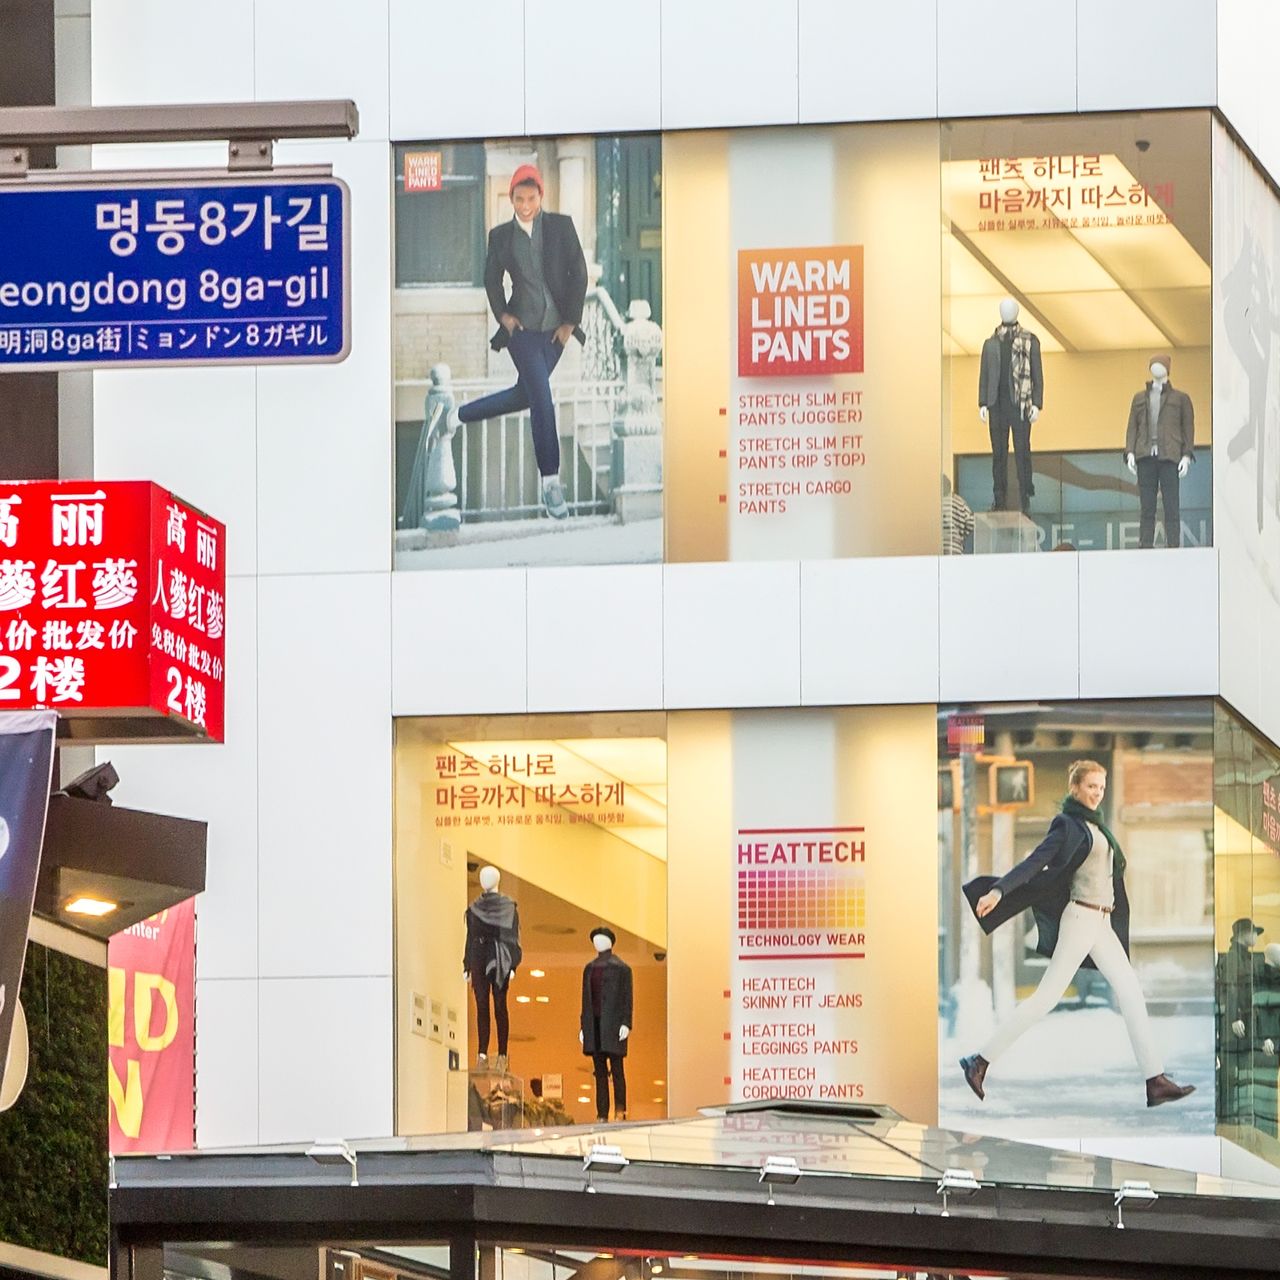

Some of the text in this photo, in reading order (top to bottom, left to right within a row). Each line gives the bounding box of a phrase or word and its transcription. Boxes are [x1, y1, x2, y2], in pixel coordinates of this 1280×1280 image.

[409, 156, 437, 168] WARM
[979, 154, 1103, 182] 팬츠 하나로
[409, 167, 437, 177] LINED
[409, 177, 437, 188] PANTS
[979, 182, 1175, 214] 마음까지 따스하게
[96, 195, 328, 256] 명동8가길
[751, 259, 850, 293] WARM
[0, 266, 328, 311] eongdong 8ga-gil
[751, 294, 850, 329] LINED
[751, 329, 850, 363] PANTS
[739, 391, 863, 408] STRETCH SLIM FIT
[739, 409, 863, 426] PANTS (JOGGER)
[739, 434, 863, 452] STRETCH SLIM FIT
[739, 452, 866, 470] PANTS (RIP STOP)
[739, 480, 852, 496] STRETCH CARGO
[739, 499, 786, 514] PANTS
[166, 504, 217, 572] 高丽
[0, 619, 138, 652] 价批发价
[0, 655, 85, 702] 2楼
[166, 666, 208, 728] 2楼
[436, 753, 557, 779] 팬츠 하나로
[436, 781, 625, 810] 마음까지 따스하게
[738, 841, 866, 865] HEATTECH
[738, 933, 866, 948] TECHNOLOGY WEAR
[742, 977, 816, 992] HEATTECH
[742, 993, 864, 1010] SKINNY FIT JEANS
[742, 1023, 816, 1038] HEATTECH
[742, 1040, 859, 1056] LEGGINGS PANTS
[742, 1067, 816, 1082] HEATTECH
[742, 1084, 864, 1100] CORDUROY PANTS
